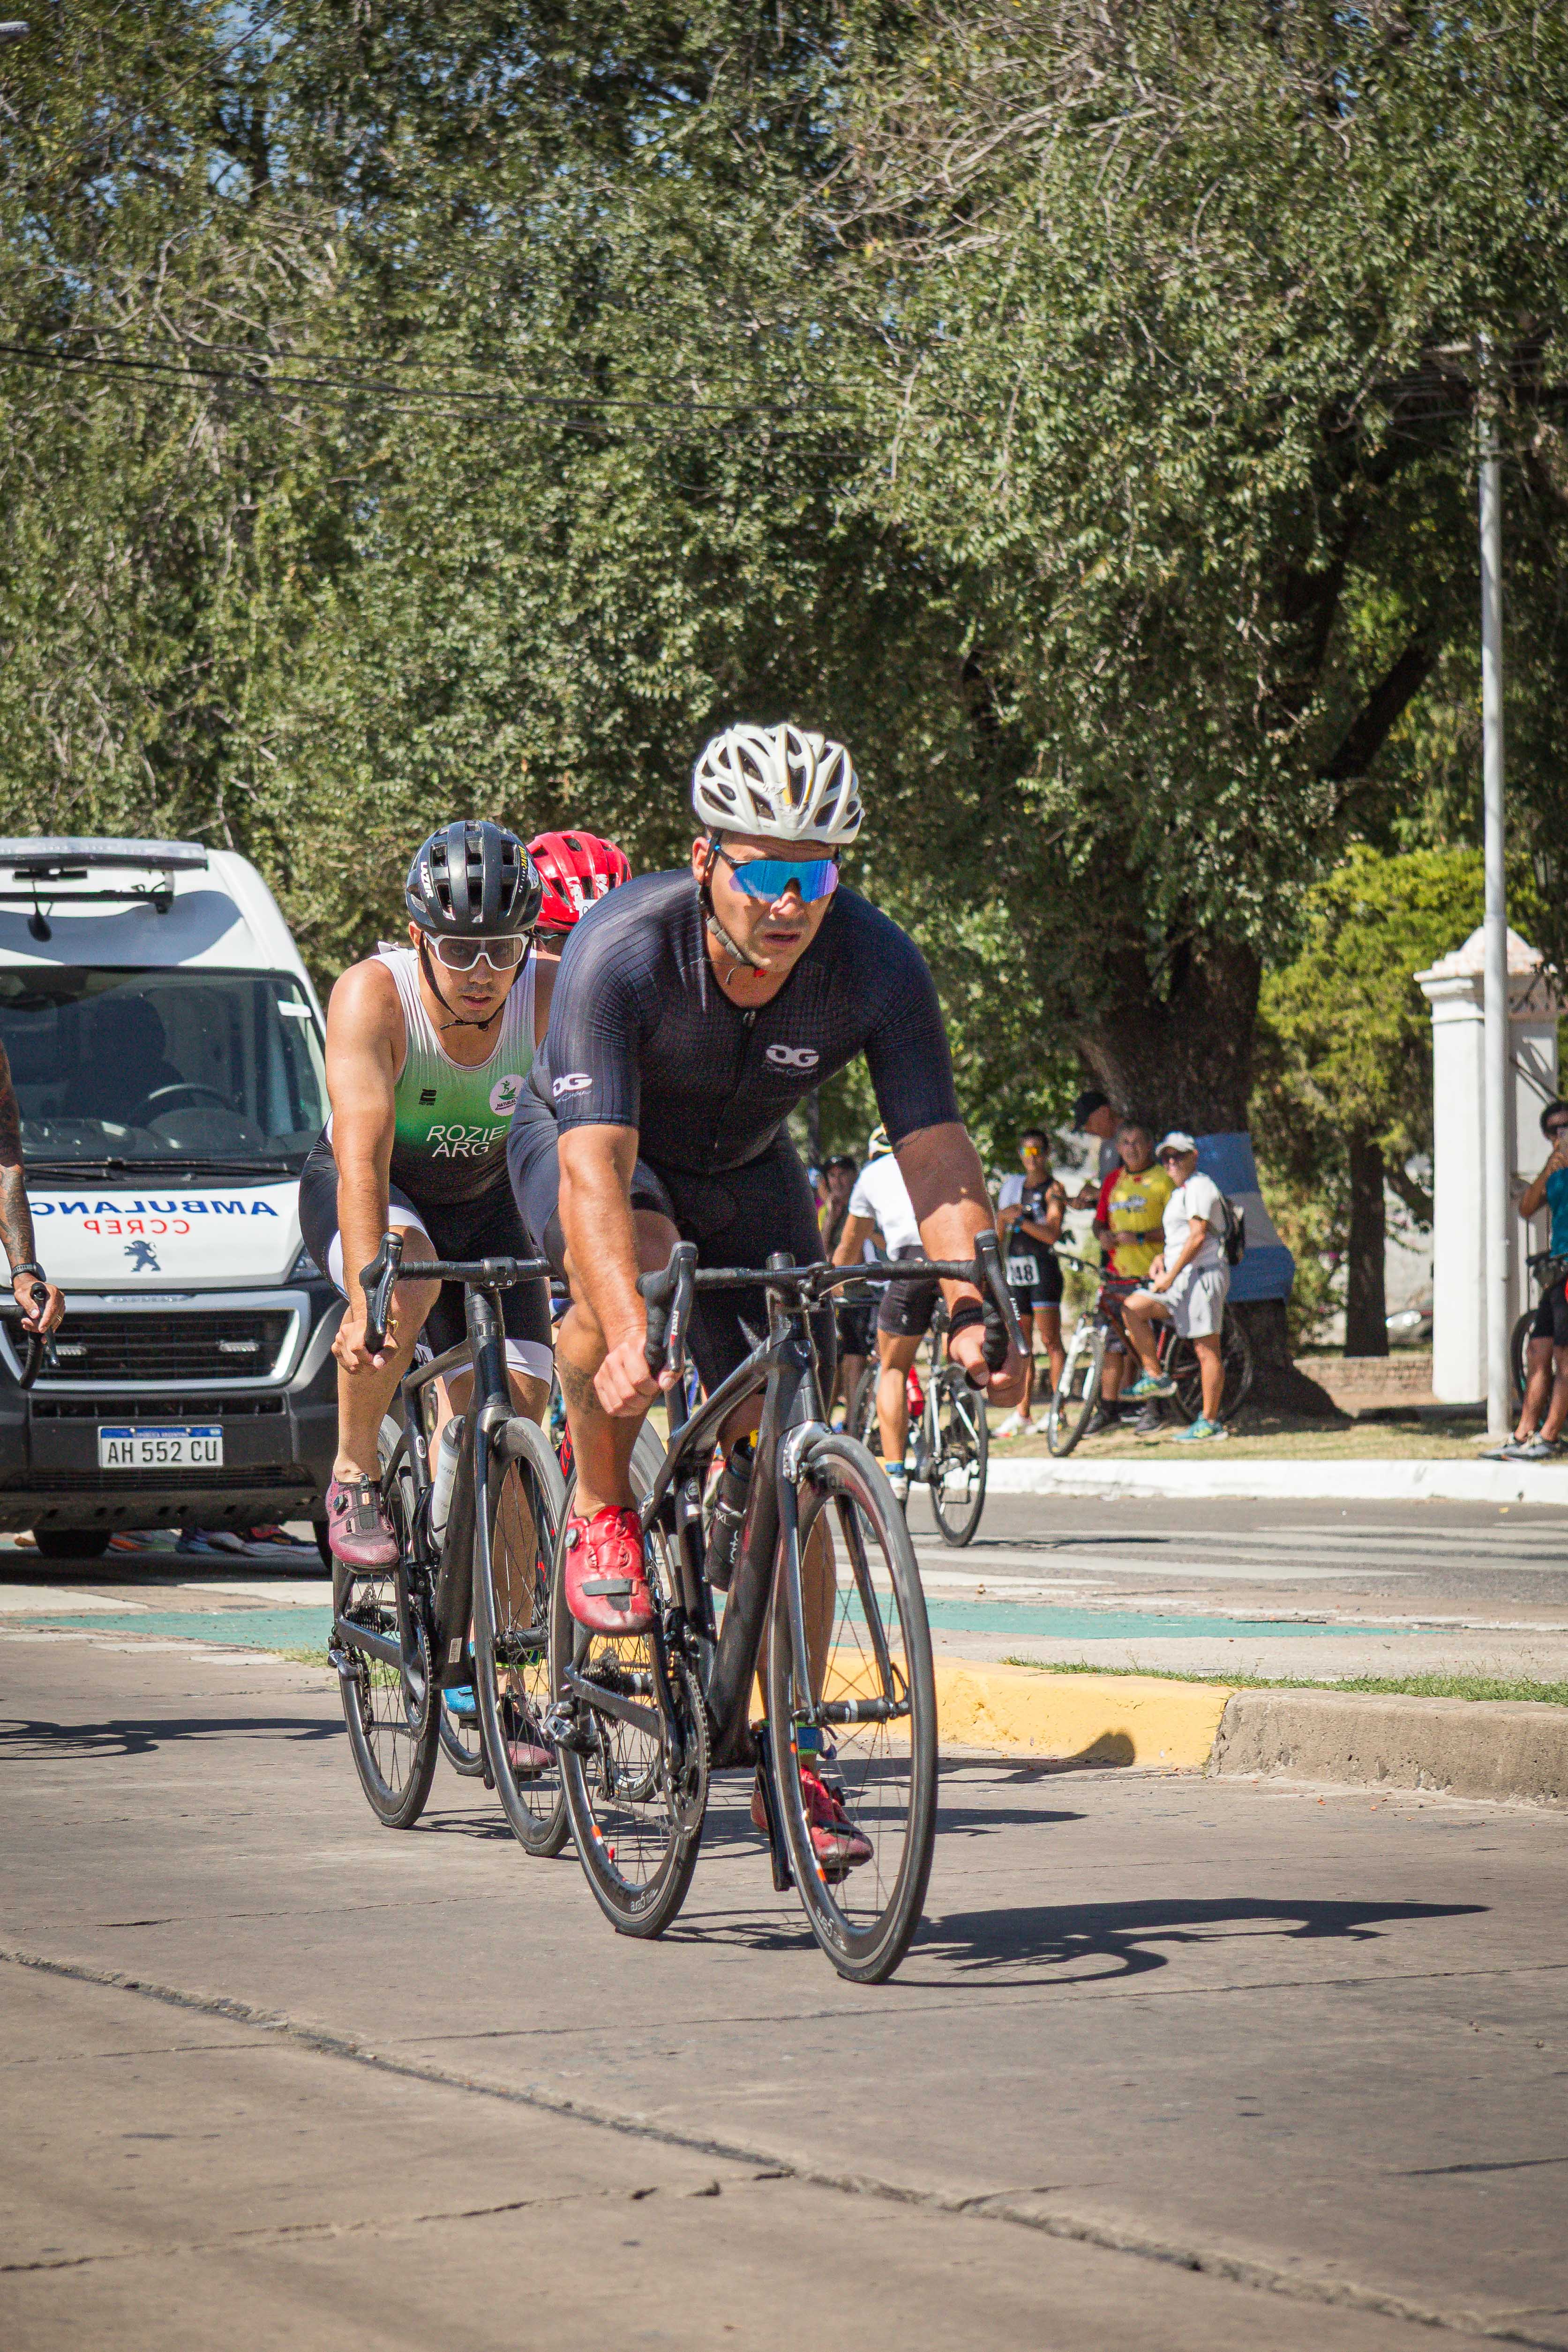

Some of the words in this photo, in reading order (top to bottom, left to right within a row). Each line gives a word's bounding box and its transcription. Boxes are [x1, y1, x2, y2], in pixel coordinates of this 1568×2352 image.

[420, 861, 434, 899] LAZER
[426, 1124, 507, 1143] ROZIE
[431, 1141, 490, 1158] ARG
[108, 1441, 134, 1463] AH
[142, 1441, 182, 1462] 552
[191, 1440, 218, 1462] CU
